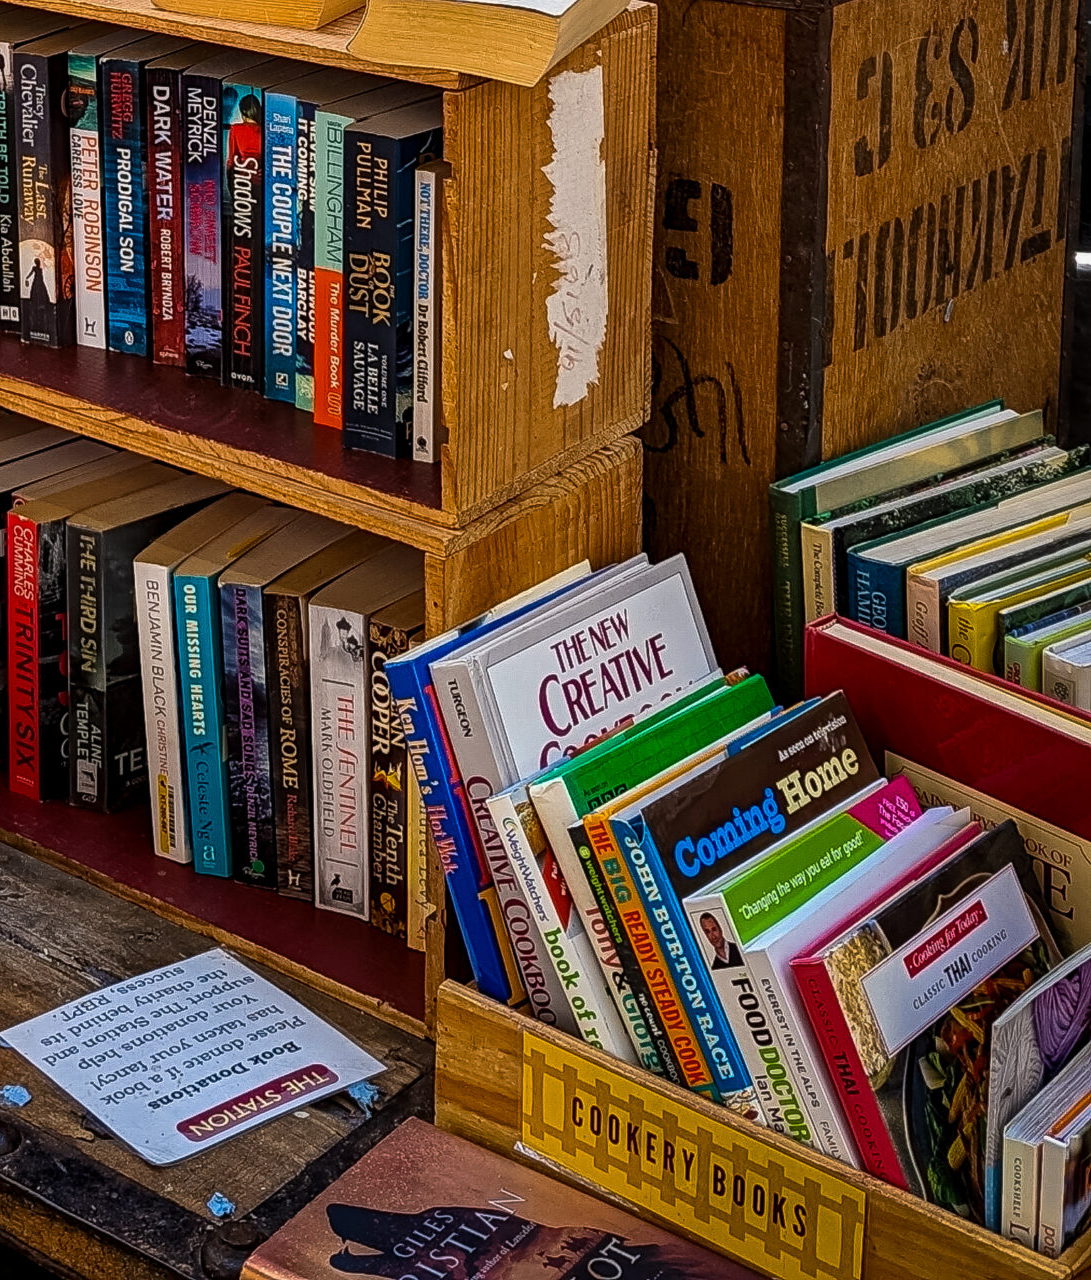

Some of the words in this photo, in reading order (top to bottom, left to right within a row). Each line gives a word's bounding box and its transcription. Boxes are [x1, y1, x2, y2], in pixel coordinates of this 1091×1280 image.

[81, 136, 100, 191] PETER
[272, 145, 291, 176] THE
[356, 142, 372, 229] PULLMAN
[374, 157, 388, 218] PHILIP
[83, 200, 102, 292] ROBINSON
[272, 181, 293, 261] COUPLE
[273, 262, 291, 308] NEXT
[272, 310, 292, 356] DOOR
[183, 584, 195, 614] OUR
[13, 608, 36, 719] TRINITY
[185, 619, 200, 678] MISSING
[550, 636, 587, 674] THE
[589, 608, 629, 652] NEW
[190, 683, 206, 736] HEARTS
[447, 679, 473, 737] TURGEON
[538, 633, 673, 737] CREATIVE
[14, 722, 36, 770] SIX
[673, 789, 785, 877] Coming
[777, 749, 860, 814] Home
[912, 978, 945, 1010] CLASSIC
[943, 952, 972, 987] THAI
[972, 929, 1008, 963] COOKING
[247, 1041, 302, 1067] Book
[285, 1070, 330, 1094] THE
[149, 1064, 250, 1110] Donations
[189, 1086, 283, 1137] STATION
[571, 1096, 696, 1182] COOKERY
[712, 1163, 808, 1238] BOOKS
